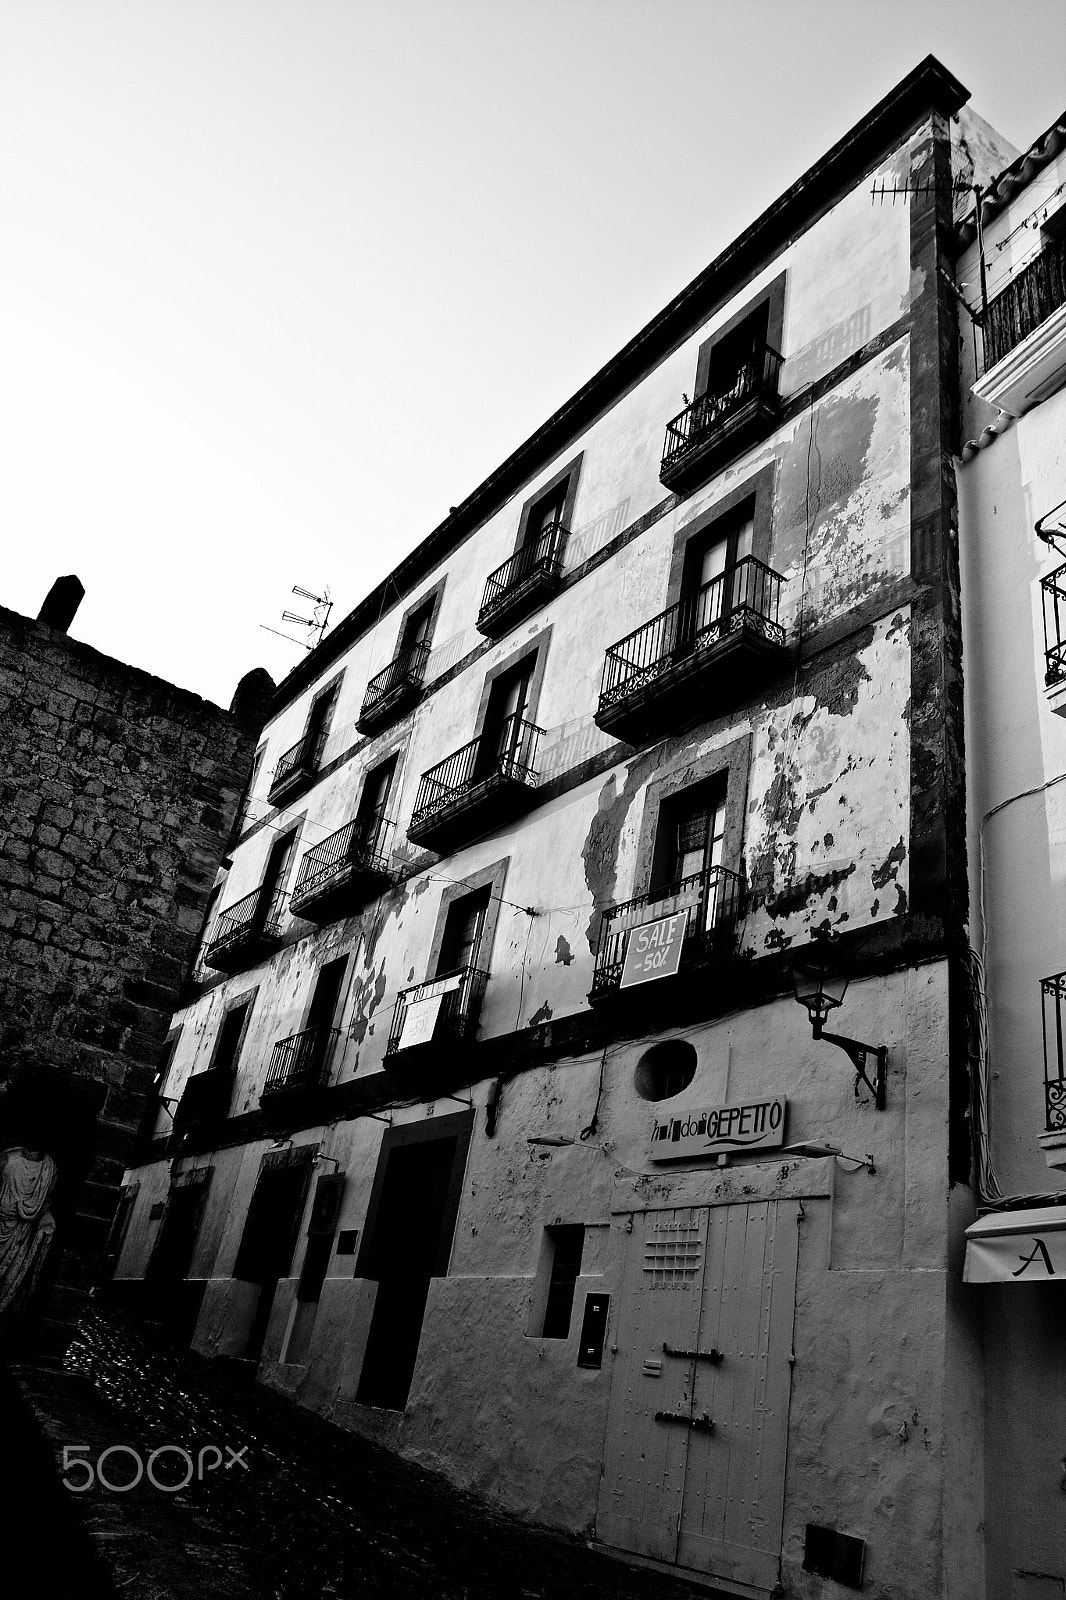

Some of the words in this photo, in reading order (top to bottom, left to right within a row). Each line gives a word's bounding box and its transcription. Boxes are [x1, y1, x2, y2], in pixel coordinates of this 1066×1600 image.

[636, 918, 678, 953] SALE
[634, 945, 671, 972] -50%
[651, 1112, 708, 1143] hldo
[707, 1101, 782, 1139] GEPETTO
[1012, 1237, 1056, 1277] A
